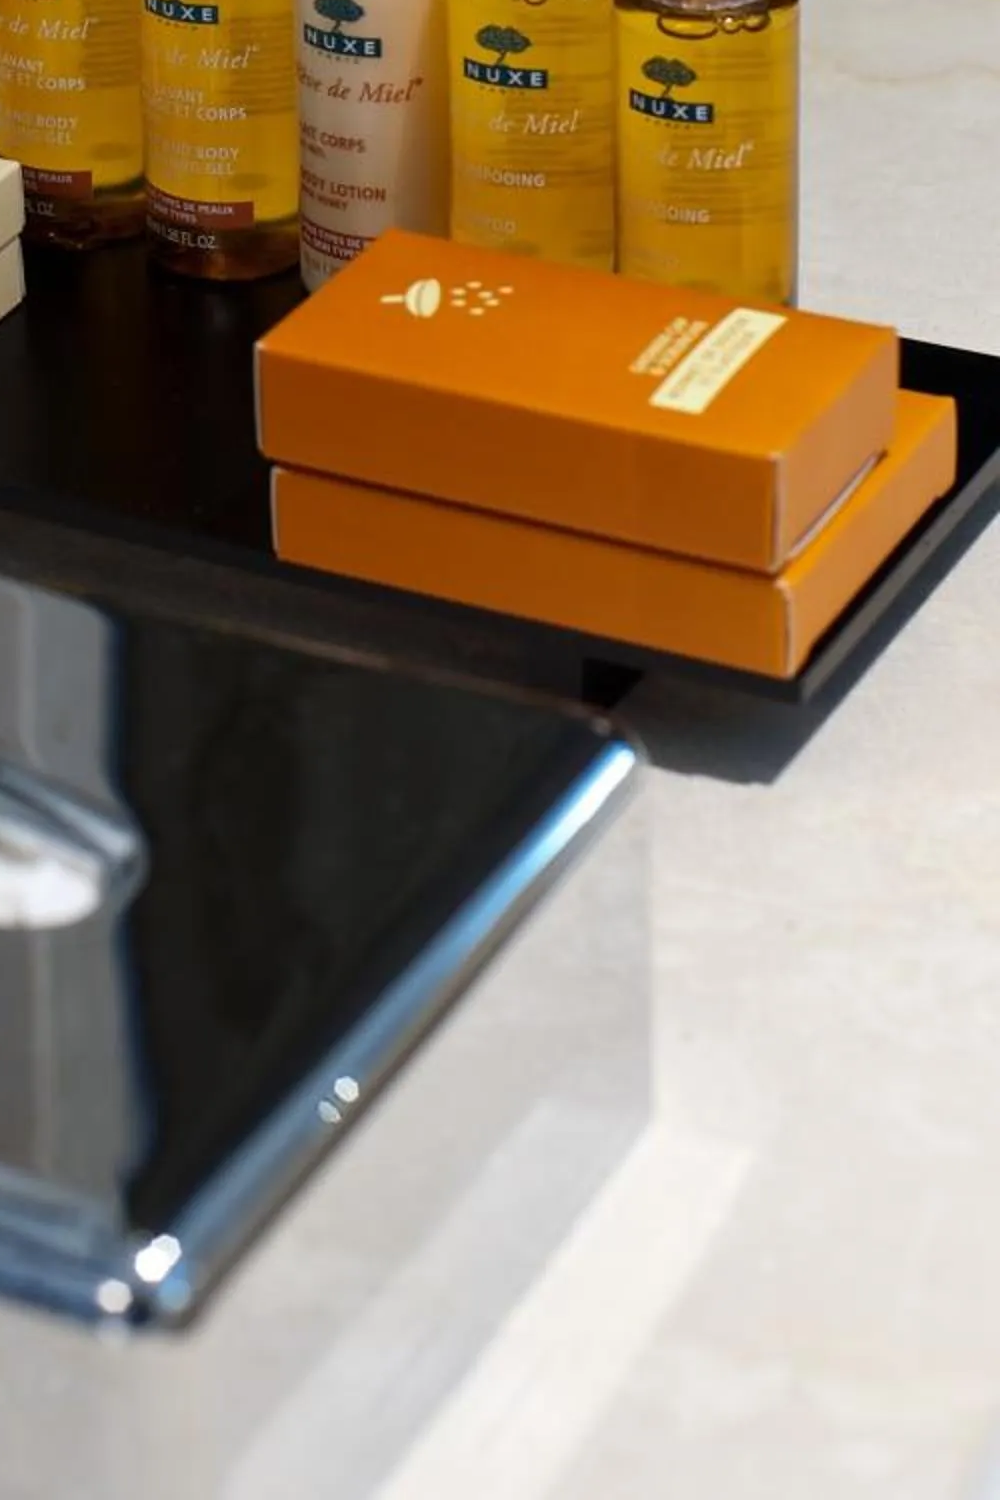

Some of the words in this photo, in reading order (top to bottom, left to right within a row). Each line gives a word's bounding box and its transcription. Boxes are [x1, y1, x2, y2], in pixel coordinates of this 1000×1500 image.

[9, 14, 29, 34] de
[306, 29, 376, 55] NUXE
[36, 77, 86, 92] CORPS
[467, 63, 544, 87] NUXE
[327, 77, 351, 100] de
[196, 107, 247, 121] CORPS
[633, 93, 709, 121] NUXE
[195, 146, 239, 160] BODY
[320, 131, 366, 154] CORPS
[329, 181, 387, 202] LOTION
[198, 204, 234, 216] PEAUX
